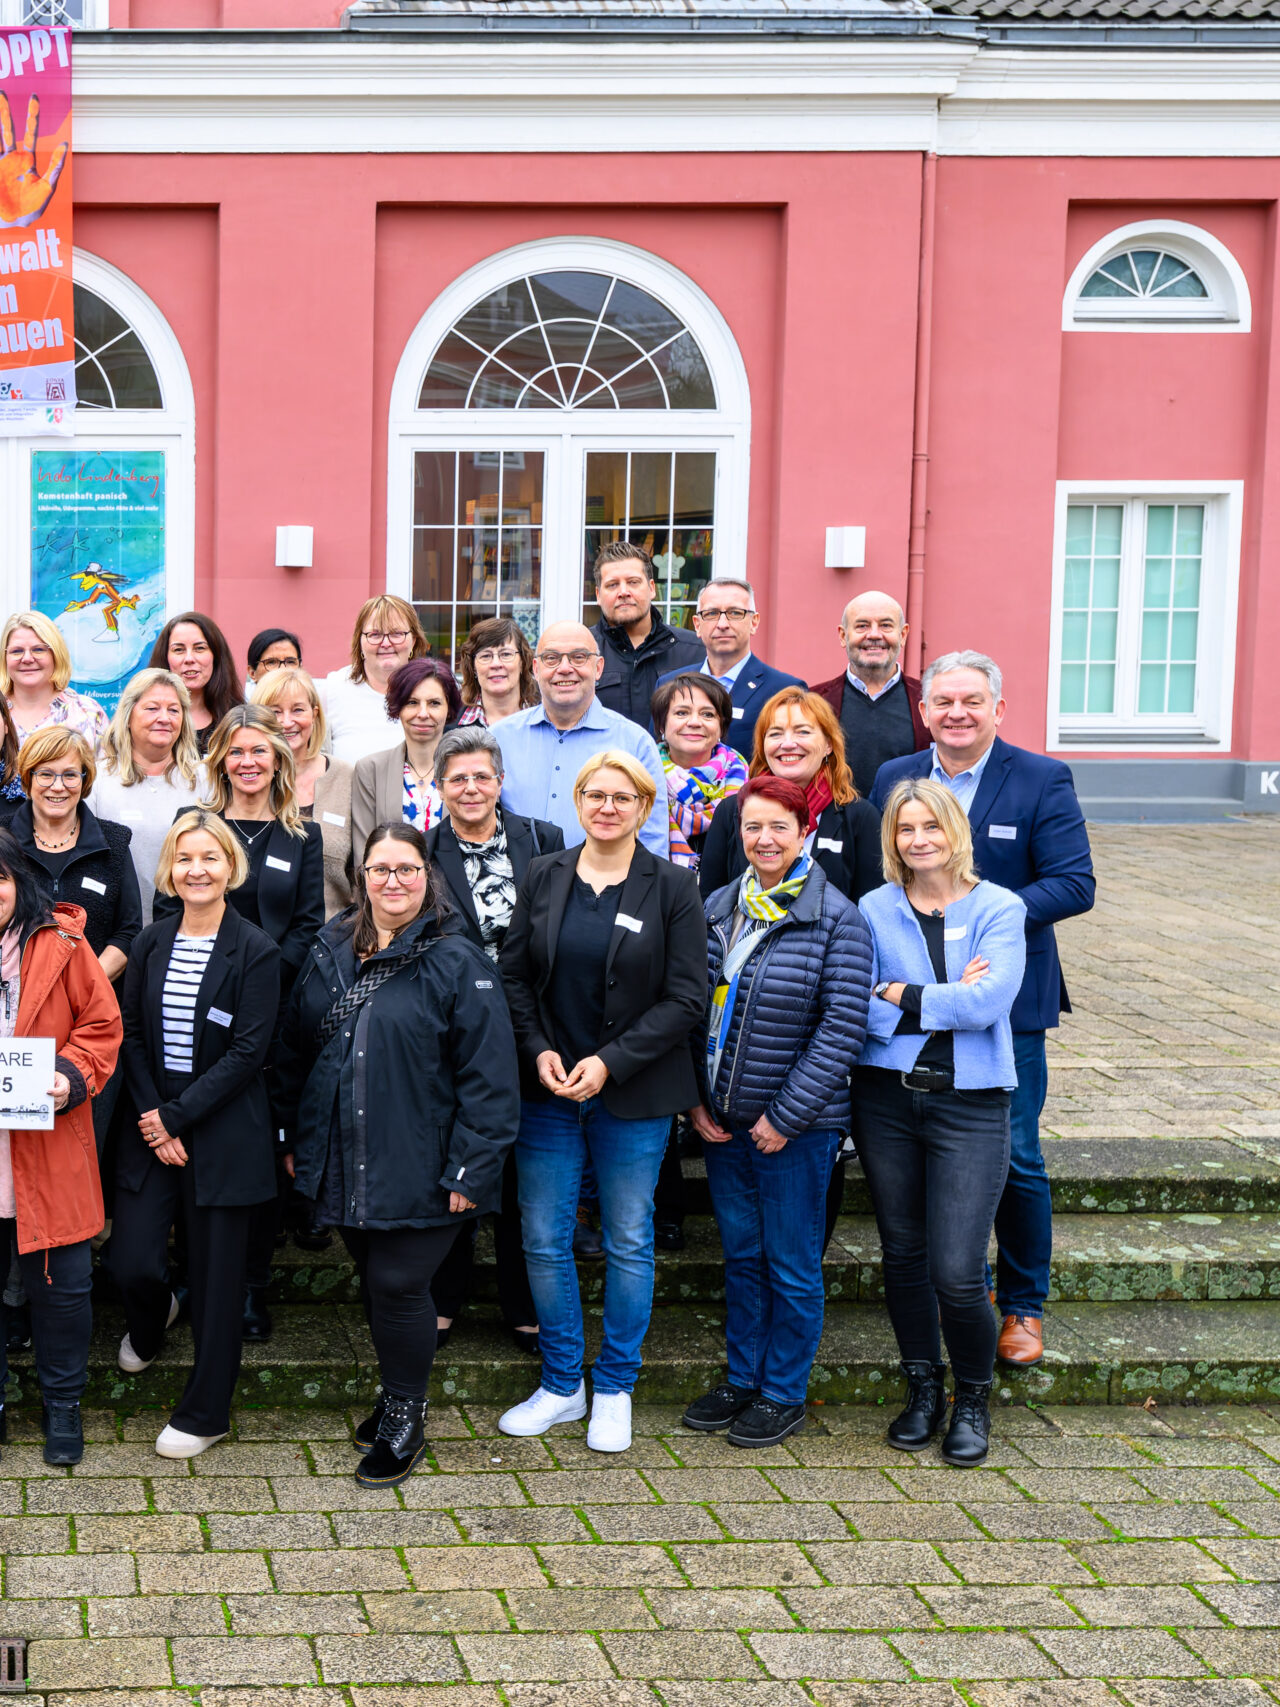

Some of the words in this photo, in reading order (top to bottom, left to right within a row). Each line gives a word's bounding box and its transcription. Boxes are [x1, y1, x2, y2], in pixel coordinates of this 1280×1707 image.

[38, 464, 72, 482] Udo
[78, 462, 160, 498] Lindenberg
[38, 492, 93, 500] Kometenhaft
[95, 492, 128, 501] panisch
